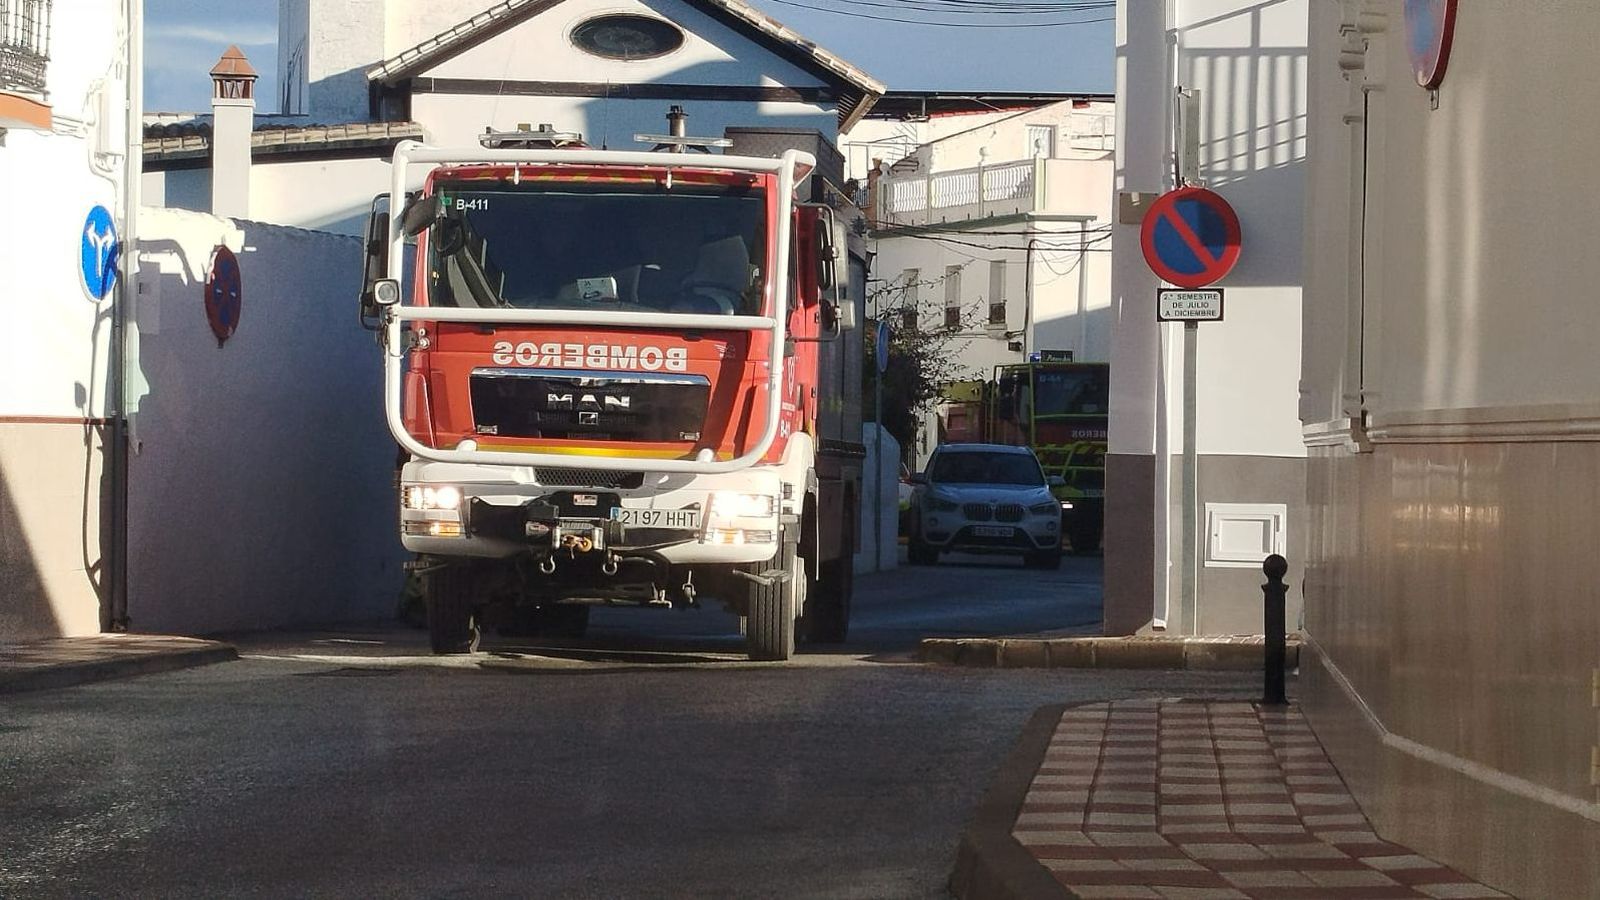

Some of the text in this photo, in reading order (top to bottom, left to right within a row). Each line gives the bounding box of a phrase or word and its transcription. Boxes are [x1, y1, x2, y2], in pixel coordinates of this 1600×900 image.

[456, 199, 488, 210] B-411
[547, 393, 631, 409] MAN
[621, 510, 661, 525] 2197
[666, 511, 697, 527] HHT
